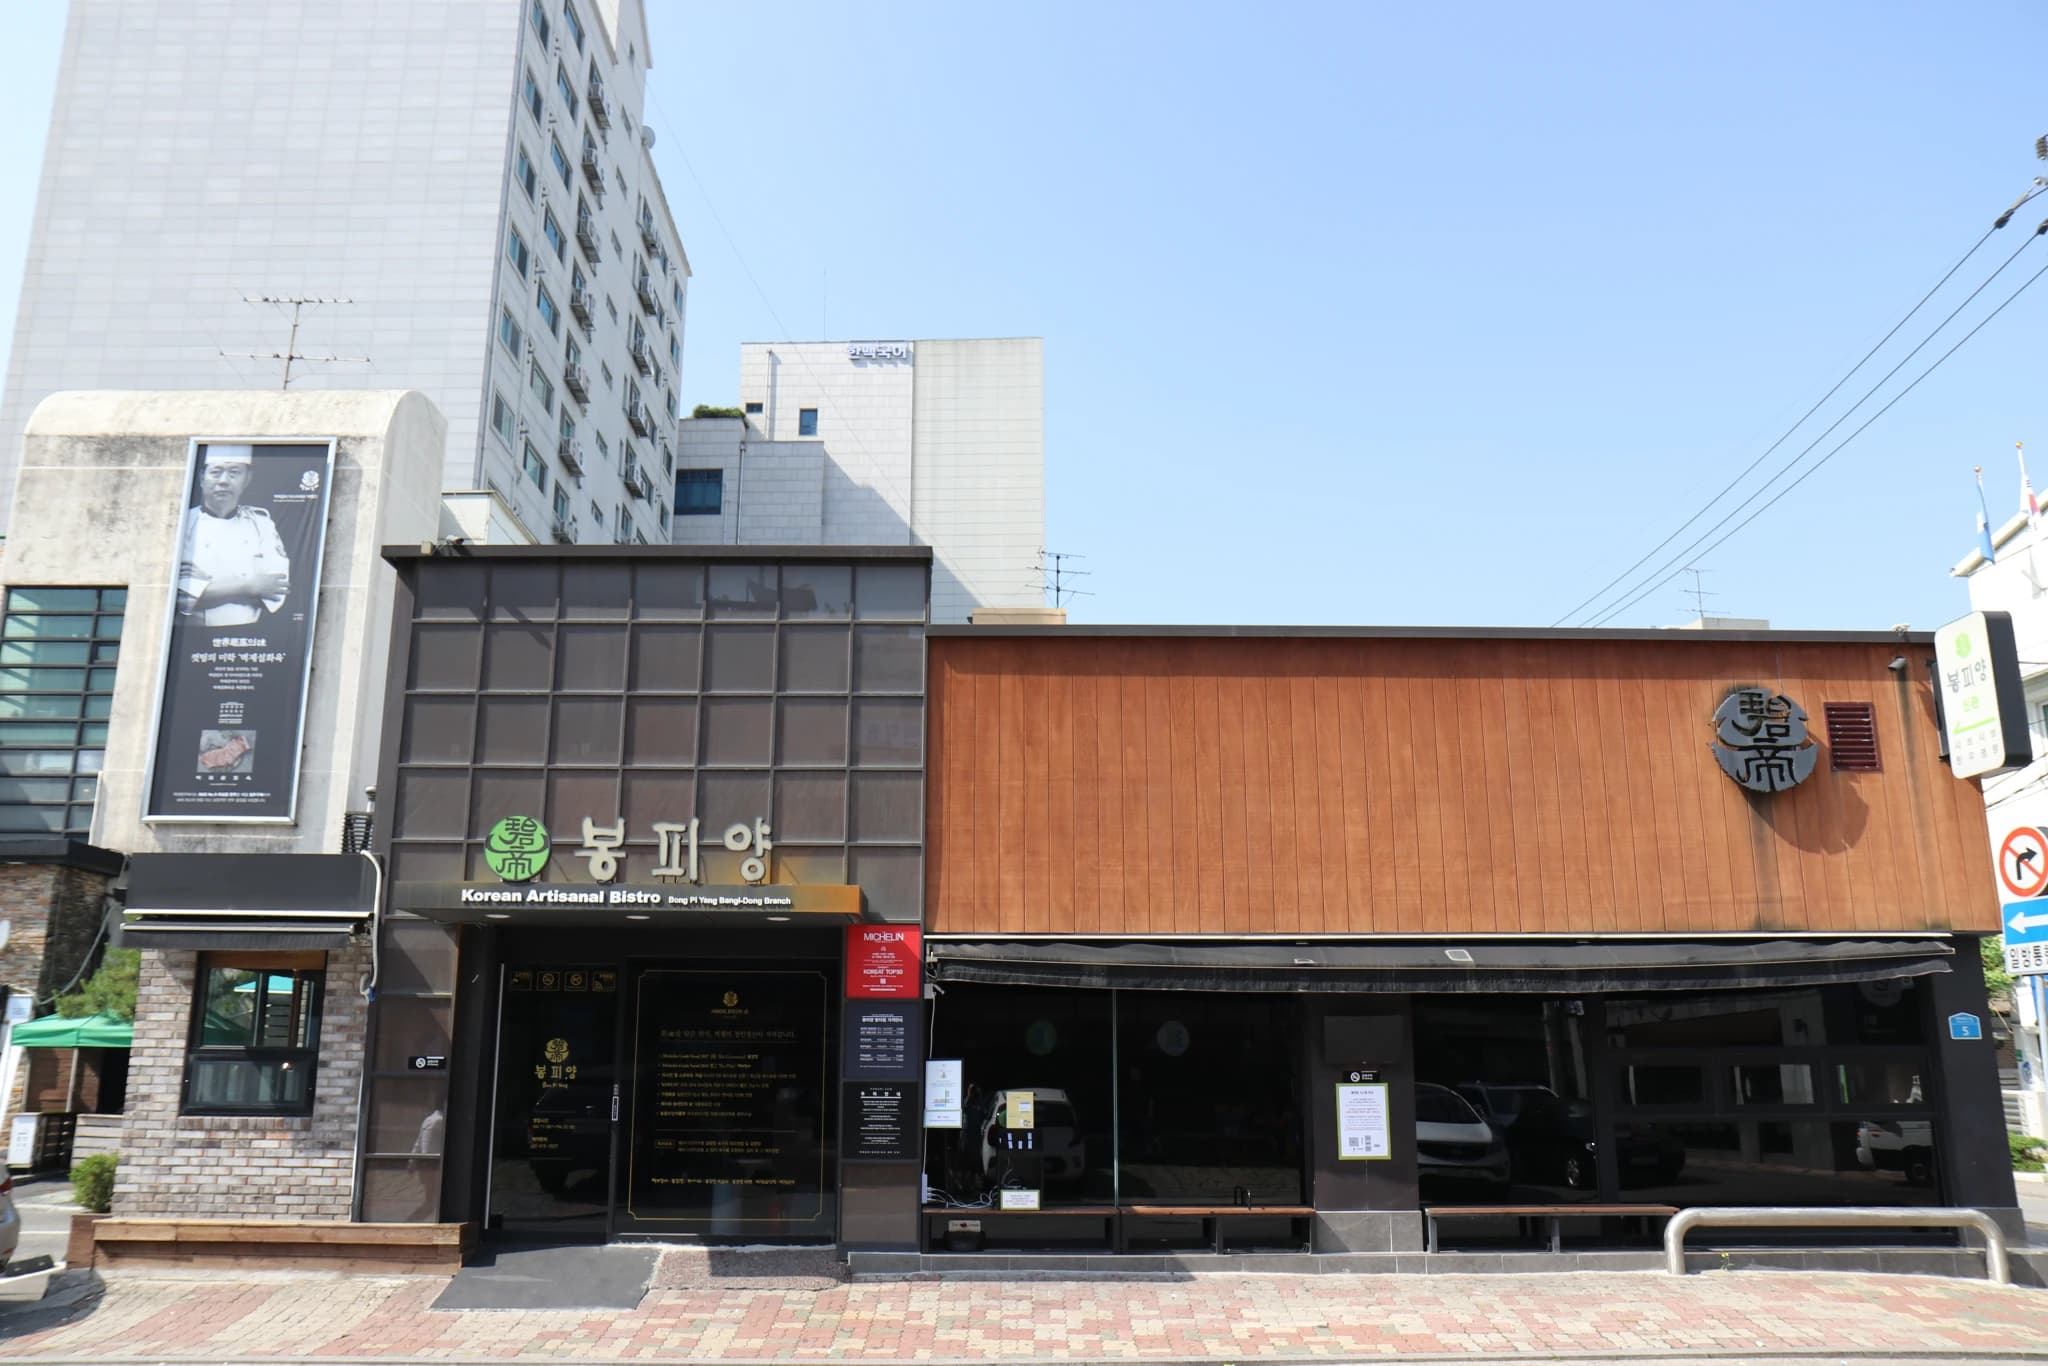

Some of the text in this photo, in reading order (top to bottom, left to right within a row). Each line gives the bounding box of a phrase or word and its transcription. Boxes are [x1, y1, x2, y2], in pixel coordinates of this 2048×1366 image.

[1946, 657, 1987, 693] 봉피양
[574, 816, 772, 881] 봉피양
[461, 888, 522, 902] Korean
[526, 889, 604, 903] Artisanal
[609, 890, 661, 904] Bistro
[699, 896, 717, 906] Yang
[719, 896, 763, 906] Bangi-Dong
[763, 896, 791, 905] Branch
[863, 932, 904, 941] MICHELIN
[1961, 1026, 1970, 1037] 5
[534, 1064, 577, 1080] 봉피양
